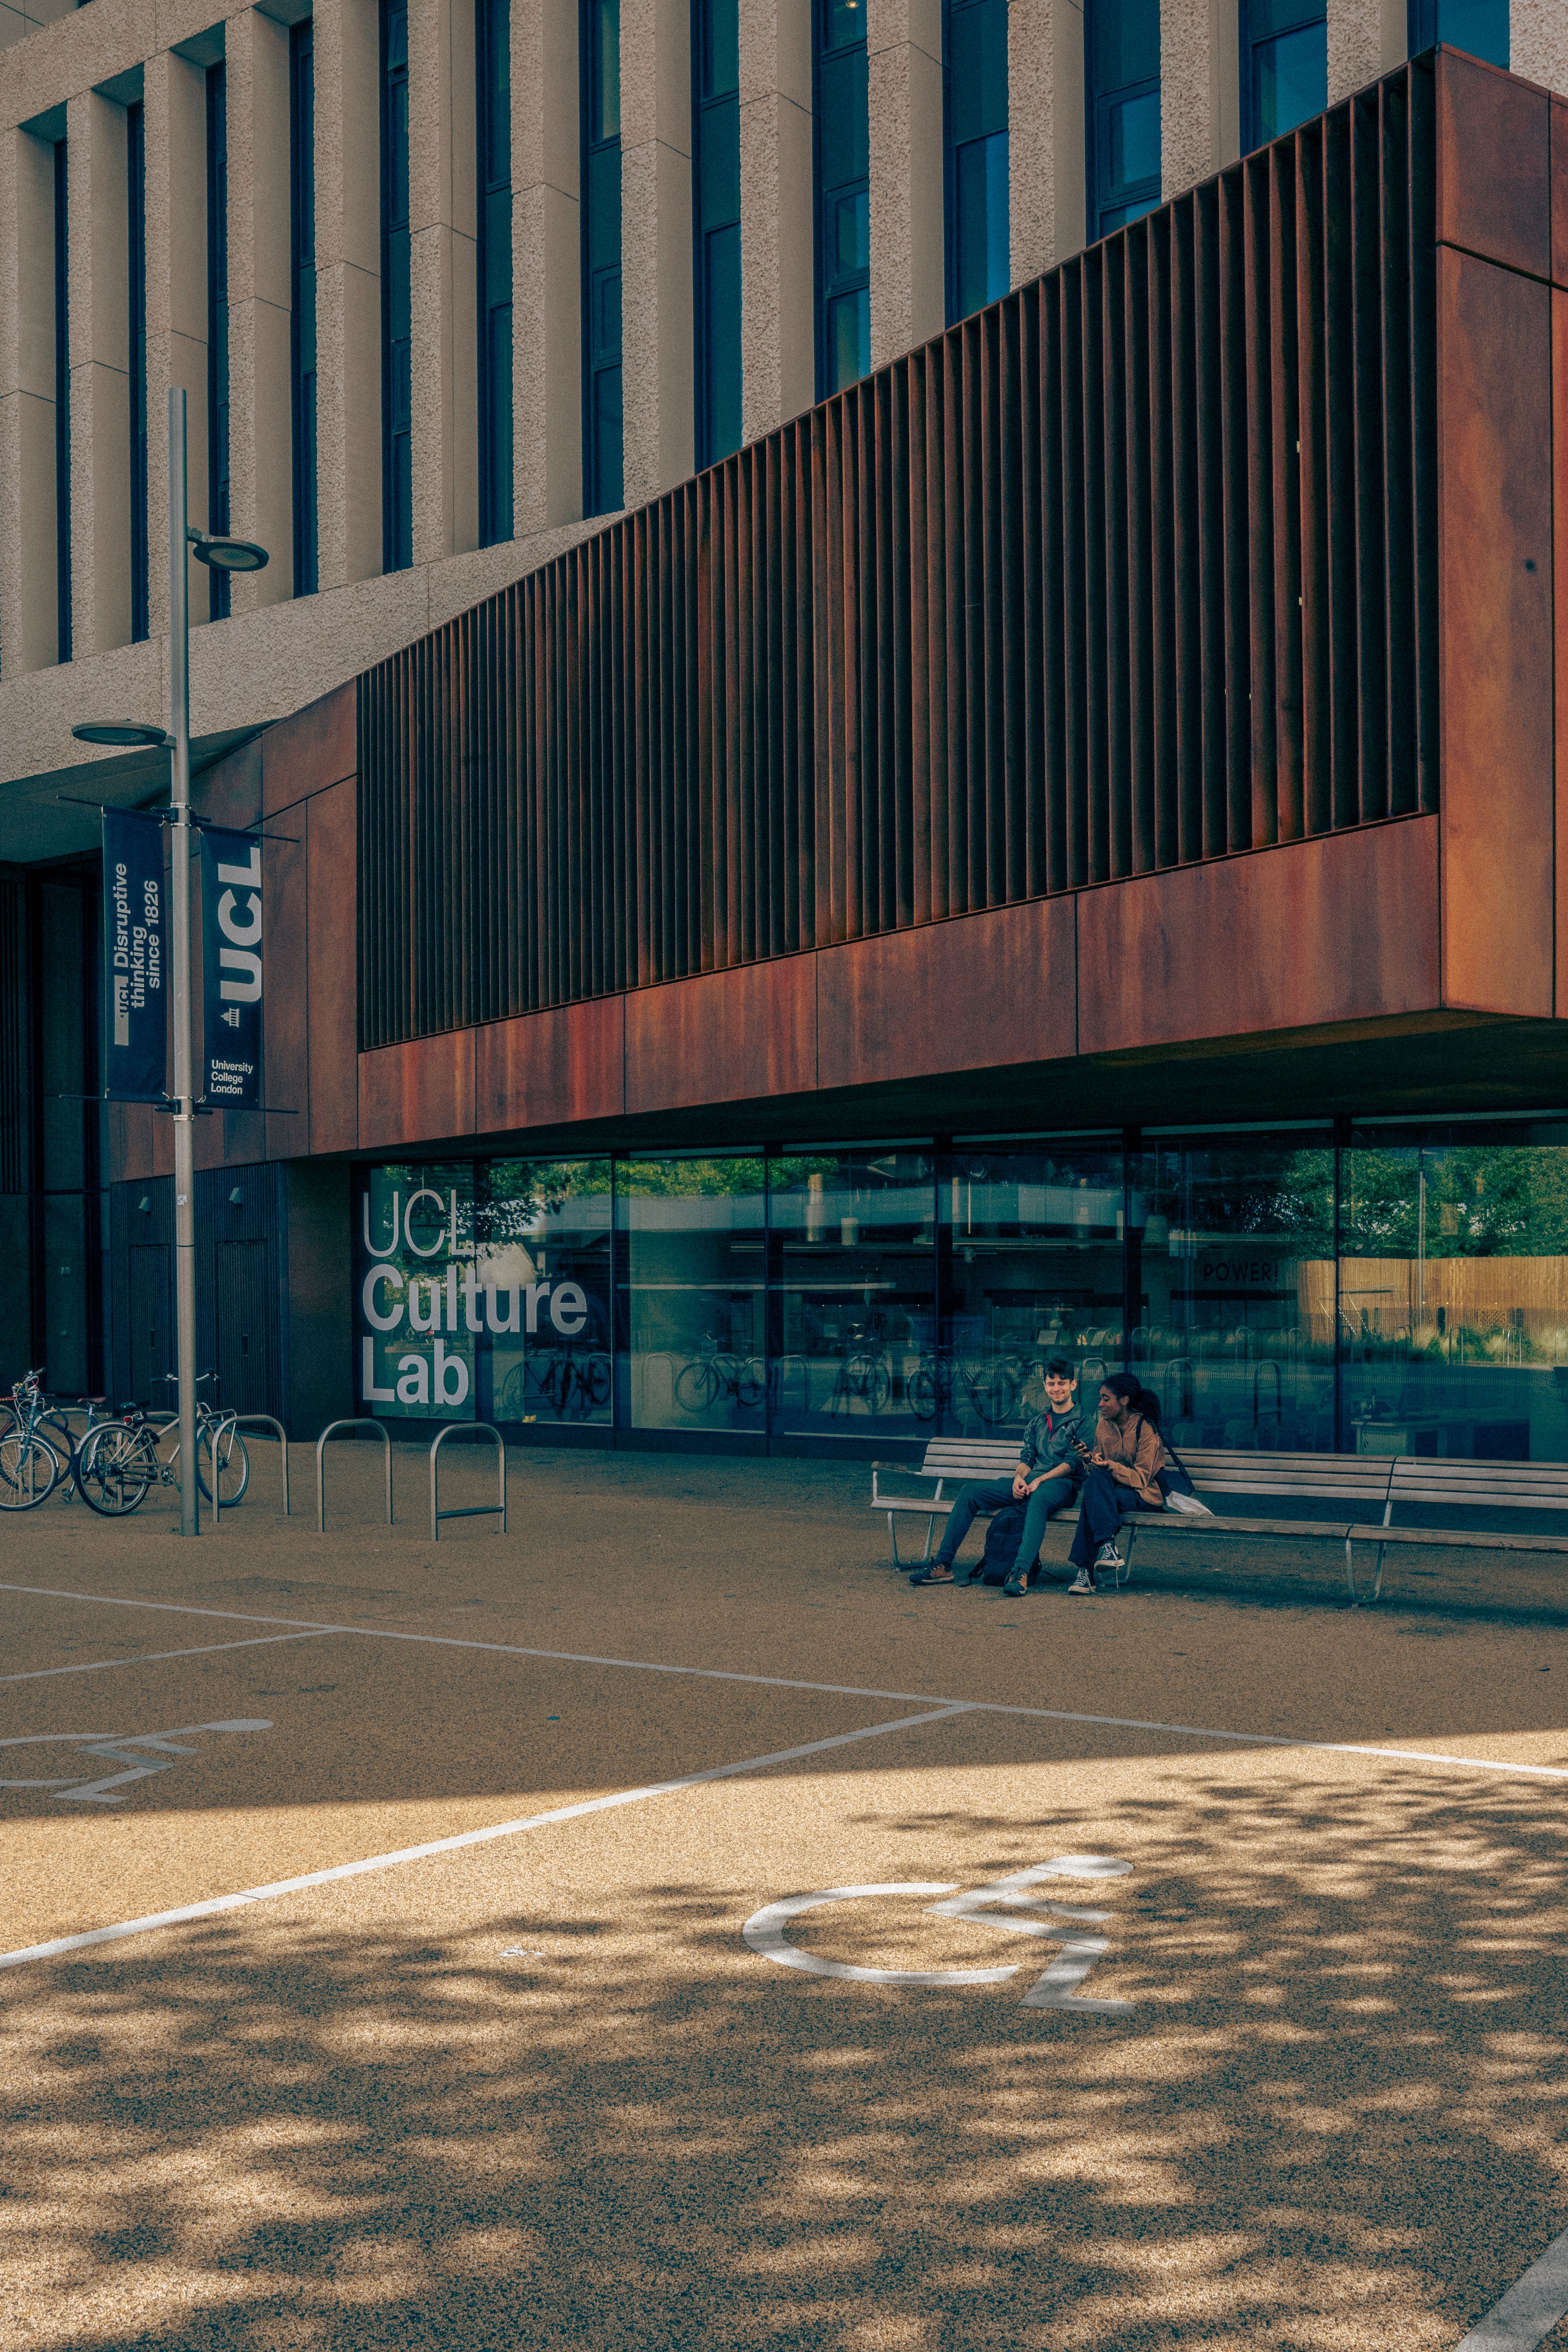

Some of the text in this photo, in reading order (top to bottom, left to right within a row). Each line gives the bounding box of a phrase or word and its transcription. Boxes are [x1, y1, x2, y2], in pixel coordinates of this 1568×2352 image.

[113, 863, 131, 968] Disruptive
[144, 880, 160, 989] since 1826
[218, 847, 262, 1002] UCL
[119, 982, 129, 1013] UCL
[130, 926, 147, 1008] thinking
[210, 1083, 243, 1095] London
[211, 1071, 243, 1085] College
[212, 1059, 253, 1074] University
[364, 1189, 482, 1257] UCL
[362, 1264, 587, 1334] Culture
[362, 1336, 469, 1406] Lab
